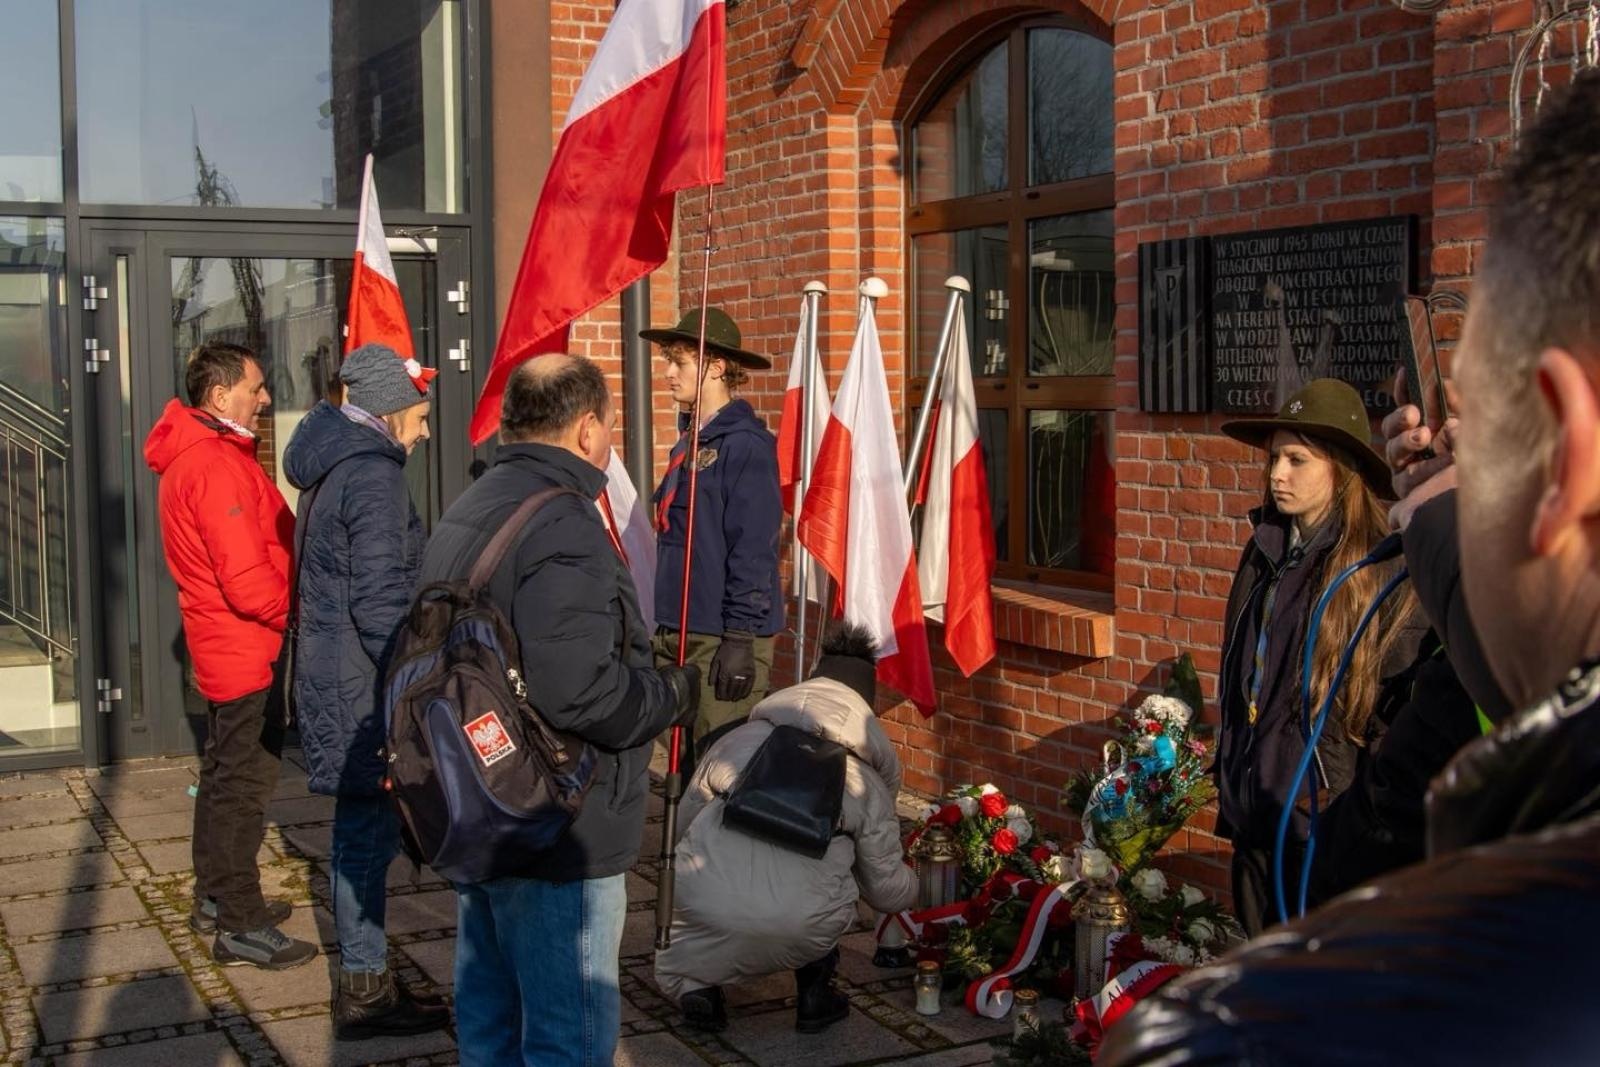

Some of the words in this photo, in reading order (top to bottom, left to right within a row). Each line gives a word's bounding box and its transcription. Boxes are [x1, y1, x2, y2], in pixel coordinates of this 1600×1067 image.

[1215, 241, 1226, 258] W
[1230, 237, 1280, 257] STYCZNIU
[1284, 235, 1307, 252] 1945
[1312, 230, 1345, 249] ROKU
[1348, 228, 1361, 246] W
[1364, 224, 1405, 243] CZASIE
[1216, 255, 1273, 276] TRAGICZNEJ
[1276, 250, 1338, 272] EWAKUACJI
[1237, 294, 1250, 310] W
[1216, 313, 1232, 329] NA
[1215, 330, 1228, 347] W
[1216, 367, 1229, 383] 30
[486, 745, 512, 763] POLSKA
